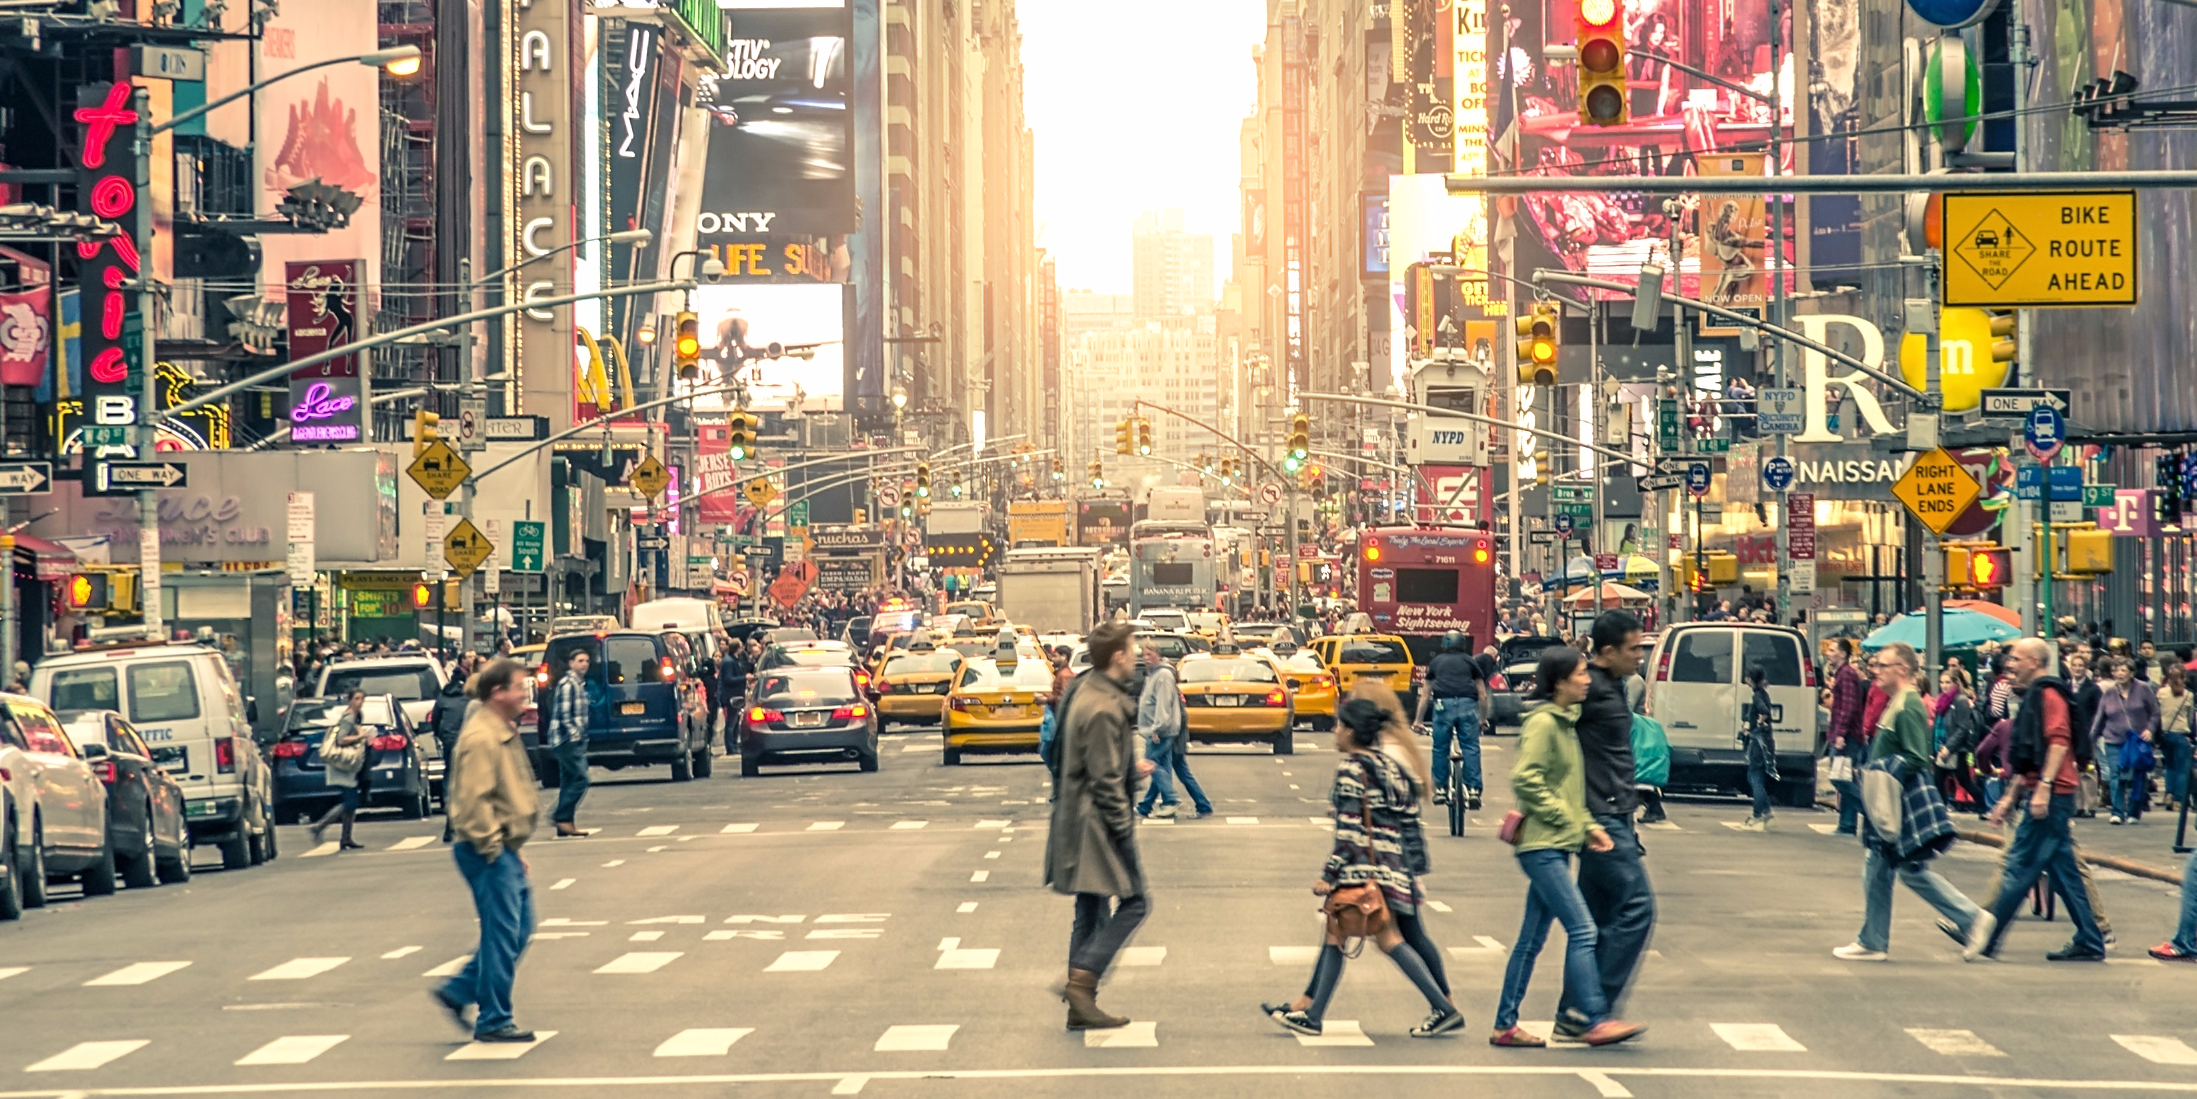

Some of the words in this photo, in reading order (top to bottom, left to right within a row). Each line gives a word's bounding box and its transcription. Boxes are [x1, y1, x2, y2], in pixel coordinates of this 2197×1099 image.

[1418, 113, 1441, 124] Hard
[2061, 206, 2109, 224] BIKE
[2049, 239, 2121, 258] ROUTE
[1979, 251, 2011, 259] SHARE
[1982, 267, 2008, 276] ROAD
[2048, 272, 2124, 291] AHEAD
[1461, 282, 1488, 296] GET
[1705, 294, 1731, 303] NOW
[1733, 294, 1762, 303] OPEN
[1792, 313, 1898, 443] R
[1764, 391, 1796, 401] NYPD
[291, 382, 354, 422] Lace
[1993, 398, 2019, 409] ONE
[1432, 430, 1465, 445] NYPD
[1663, 462, 1679, 470] ONE
[1769, 462, 1776, 473] P
[1915, 465, 1955, 478] RIGHT
[10, 473, 37, 486] WAY
[118, 470, 141, 480] ONE
[152, 470, 175, 480] WAY
[1644, 477, 1661, 487] ONE
[1917, 482, 1956, 496] LANE
[2101, 487, 2113, 497] ST
[1571, 504, 1582, 514] 47
[1919, 499, 1955, 513] ENDS
[226, 526, 272, 545] CLUB
[817, 531, 869, 545] nuchas
[518, 547, 539, 556] South
[1435, 556, 1455, 564] 71611
[821, 576, 870, 584] EMPANADAS
[351, 590, 398, 601] T-SHIRTS
[1143, 586, 1174, 596] BANANA
[1175, 586, 1211, 596] REPUBLIC
[1396, 605, 1424, 616] New
[1425, 605, 1453, 617] York
[1395, 617, 1471, 632] Sightseeing
